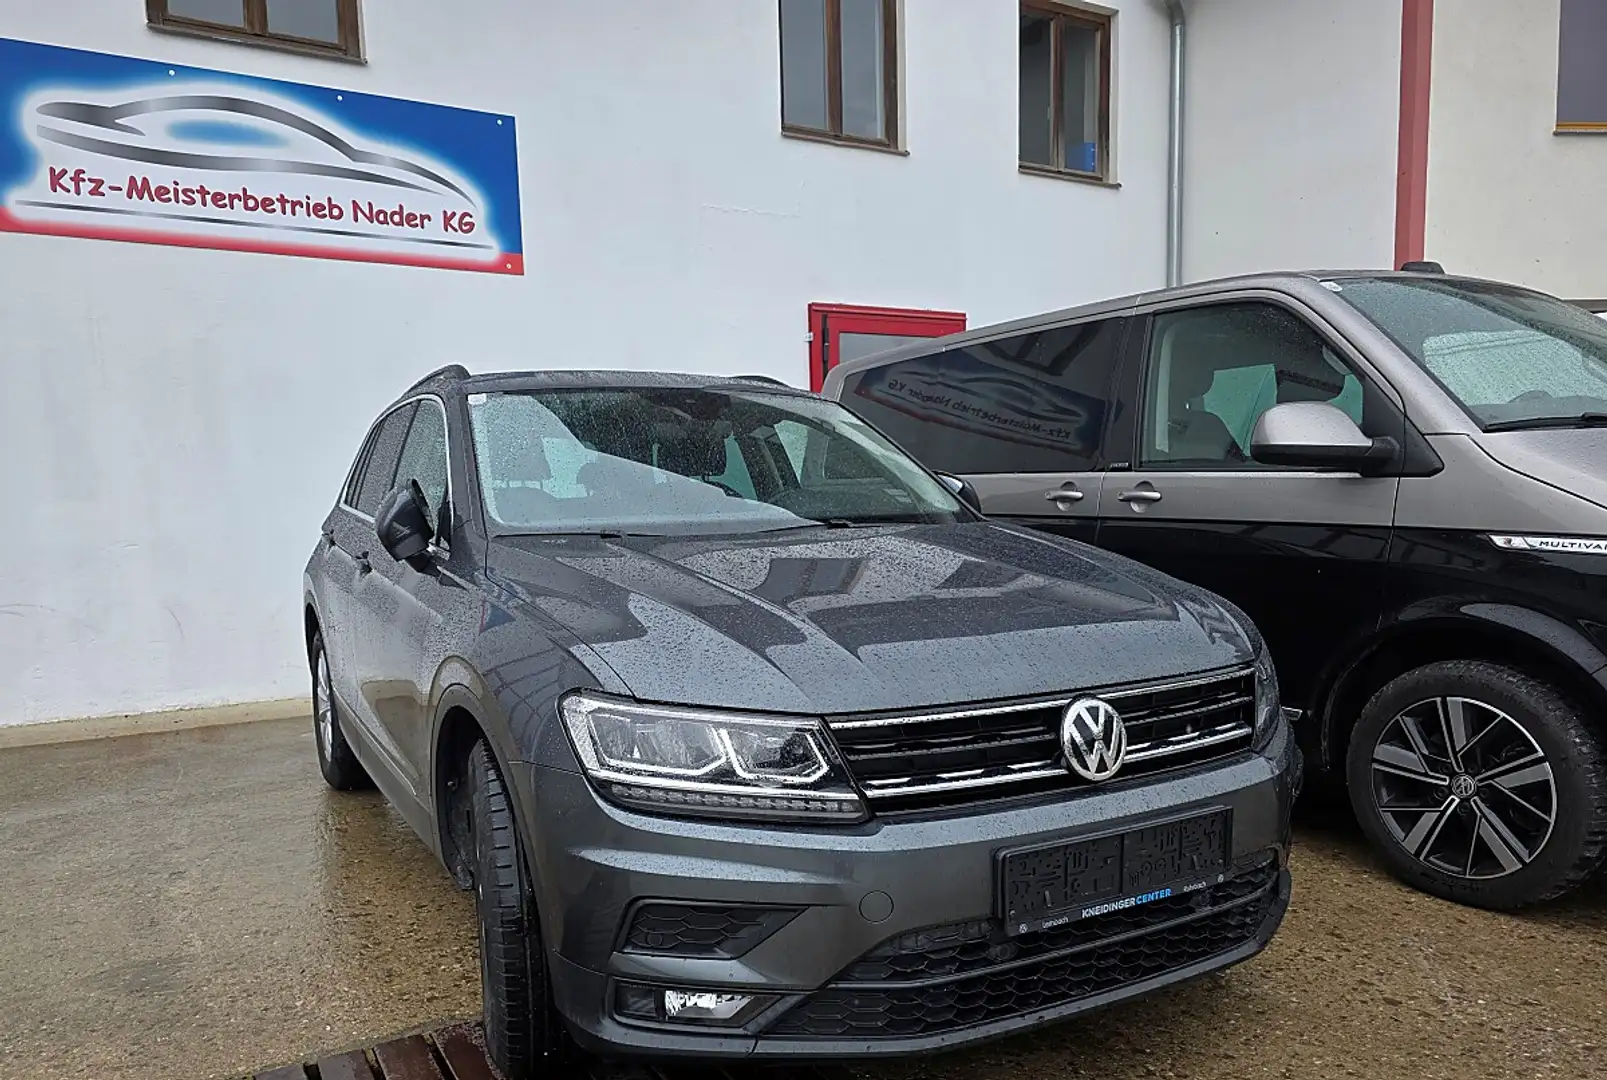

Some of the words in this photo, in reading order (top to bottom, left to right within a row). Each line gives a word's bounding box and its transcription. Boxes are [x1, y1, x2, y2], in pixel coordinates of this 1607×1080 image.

[48, 166, 344, 221] Kfz-Meisterbetrieb
[351, 199, 432, 230] Nader
[442, 209, 476, 234] KG
[1539, 541, 1607, 550] MULTIVA
